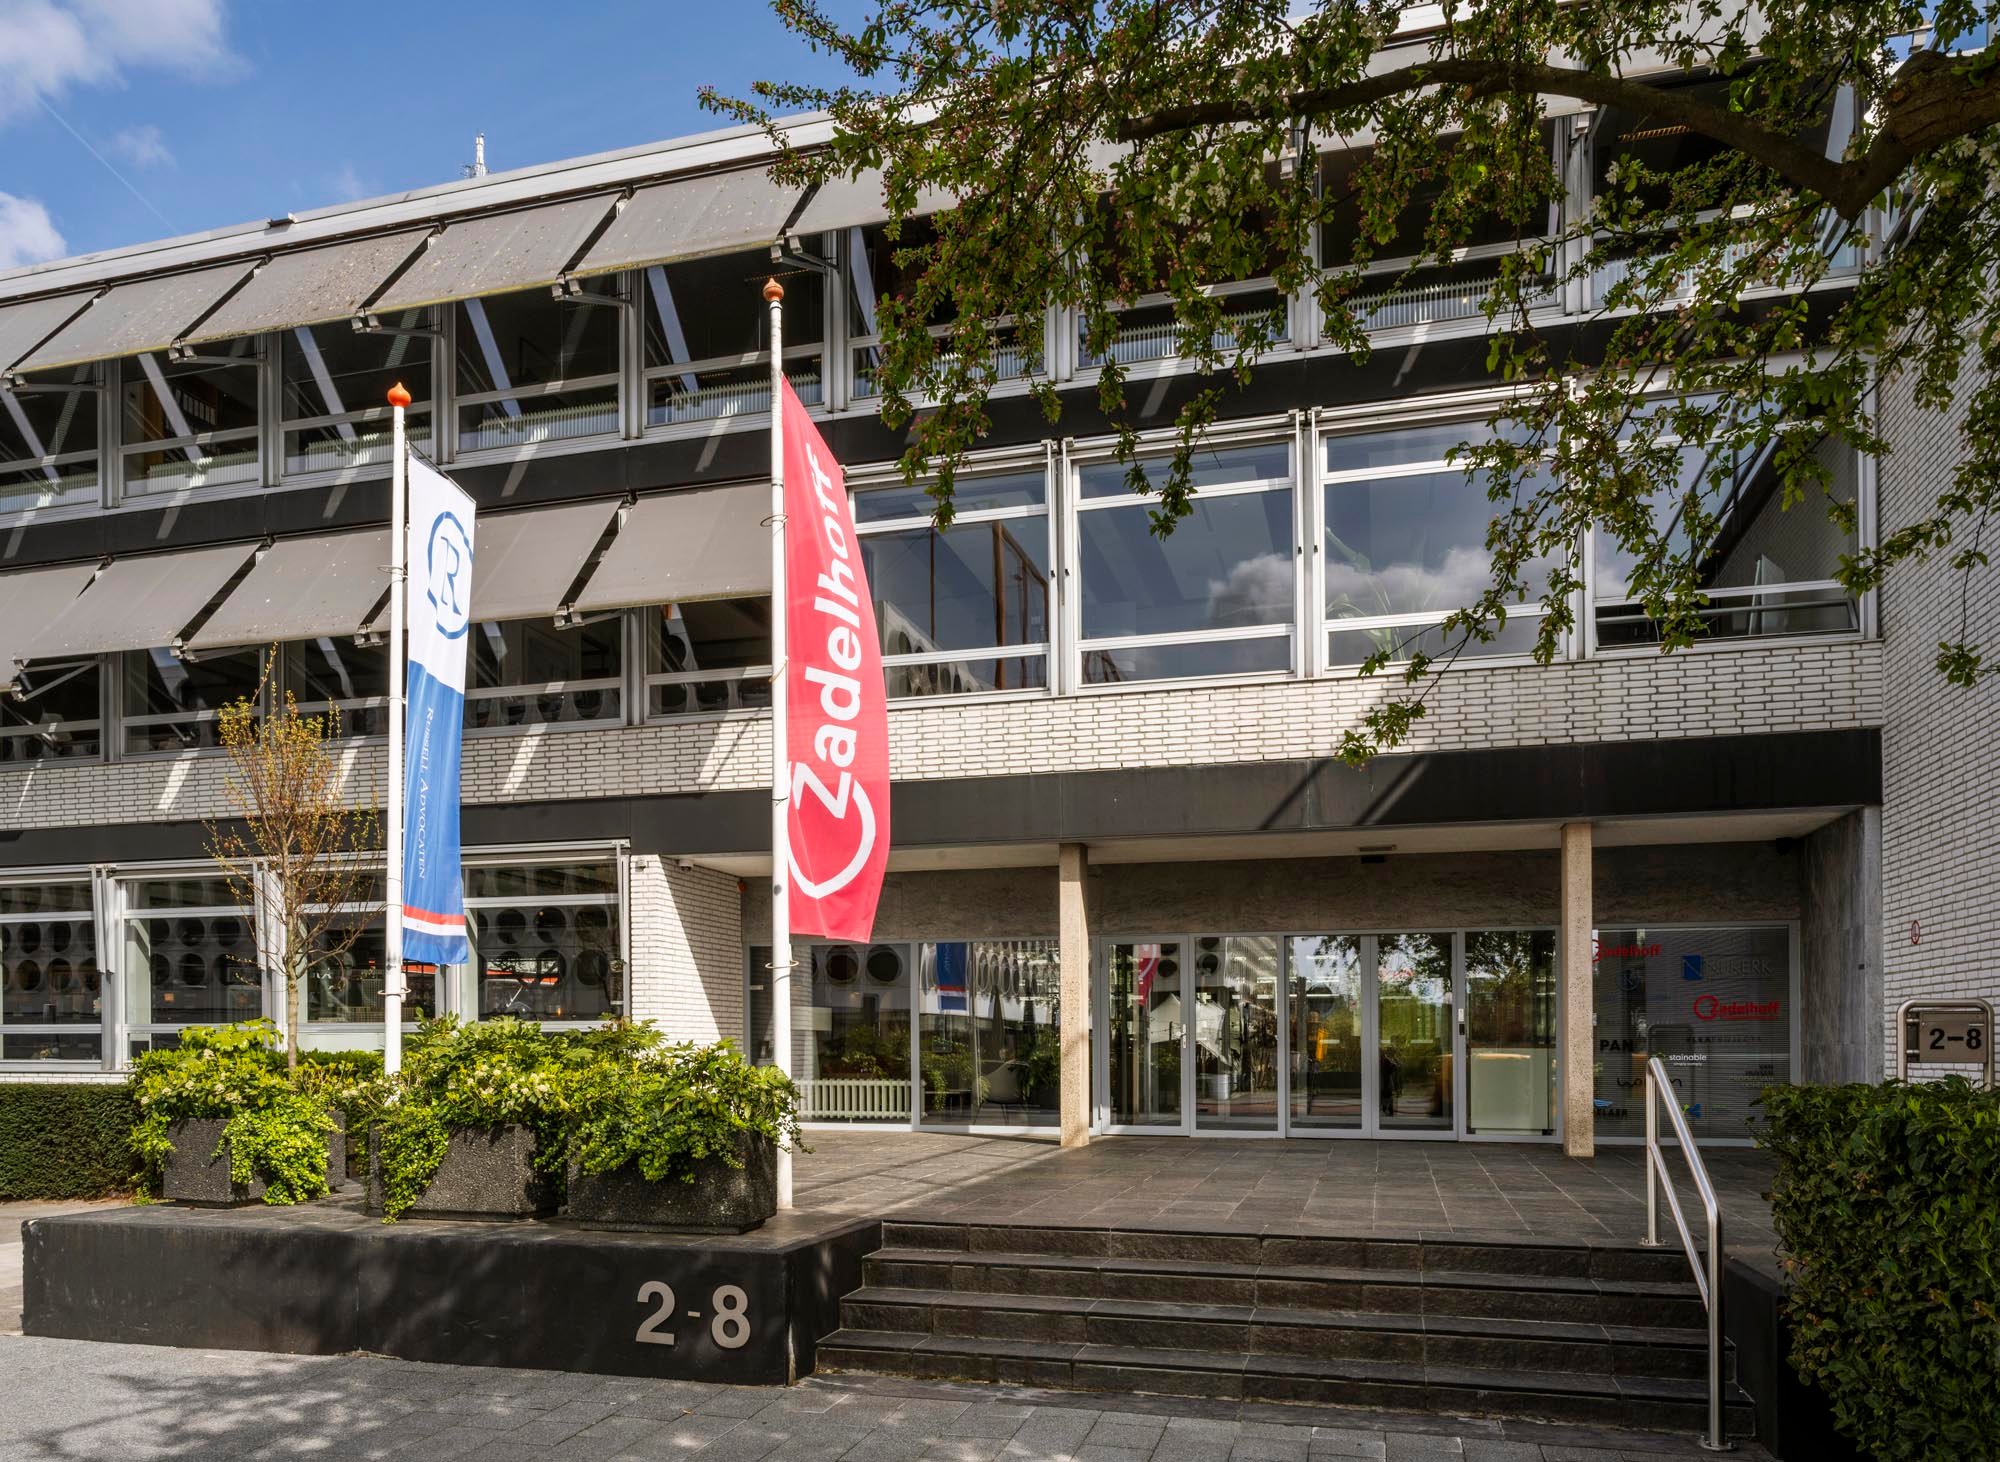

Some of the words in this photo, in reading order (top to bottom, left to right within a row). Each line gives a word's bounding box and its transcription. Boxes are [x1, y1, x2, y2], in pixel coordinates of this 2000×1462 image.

[790, 442, 863, 819] Zadelhoff
[418, 778, 429, 879] ADVOCATEN
[1600, 1039, 1633, 1051] PAN
[1929, 1028, 1982, 1050] 2-8
